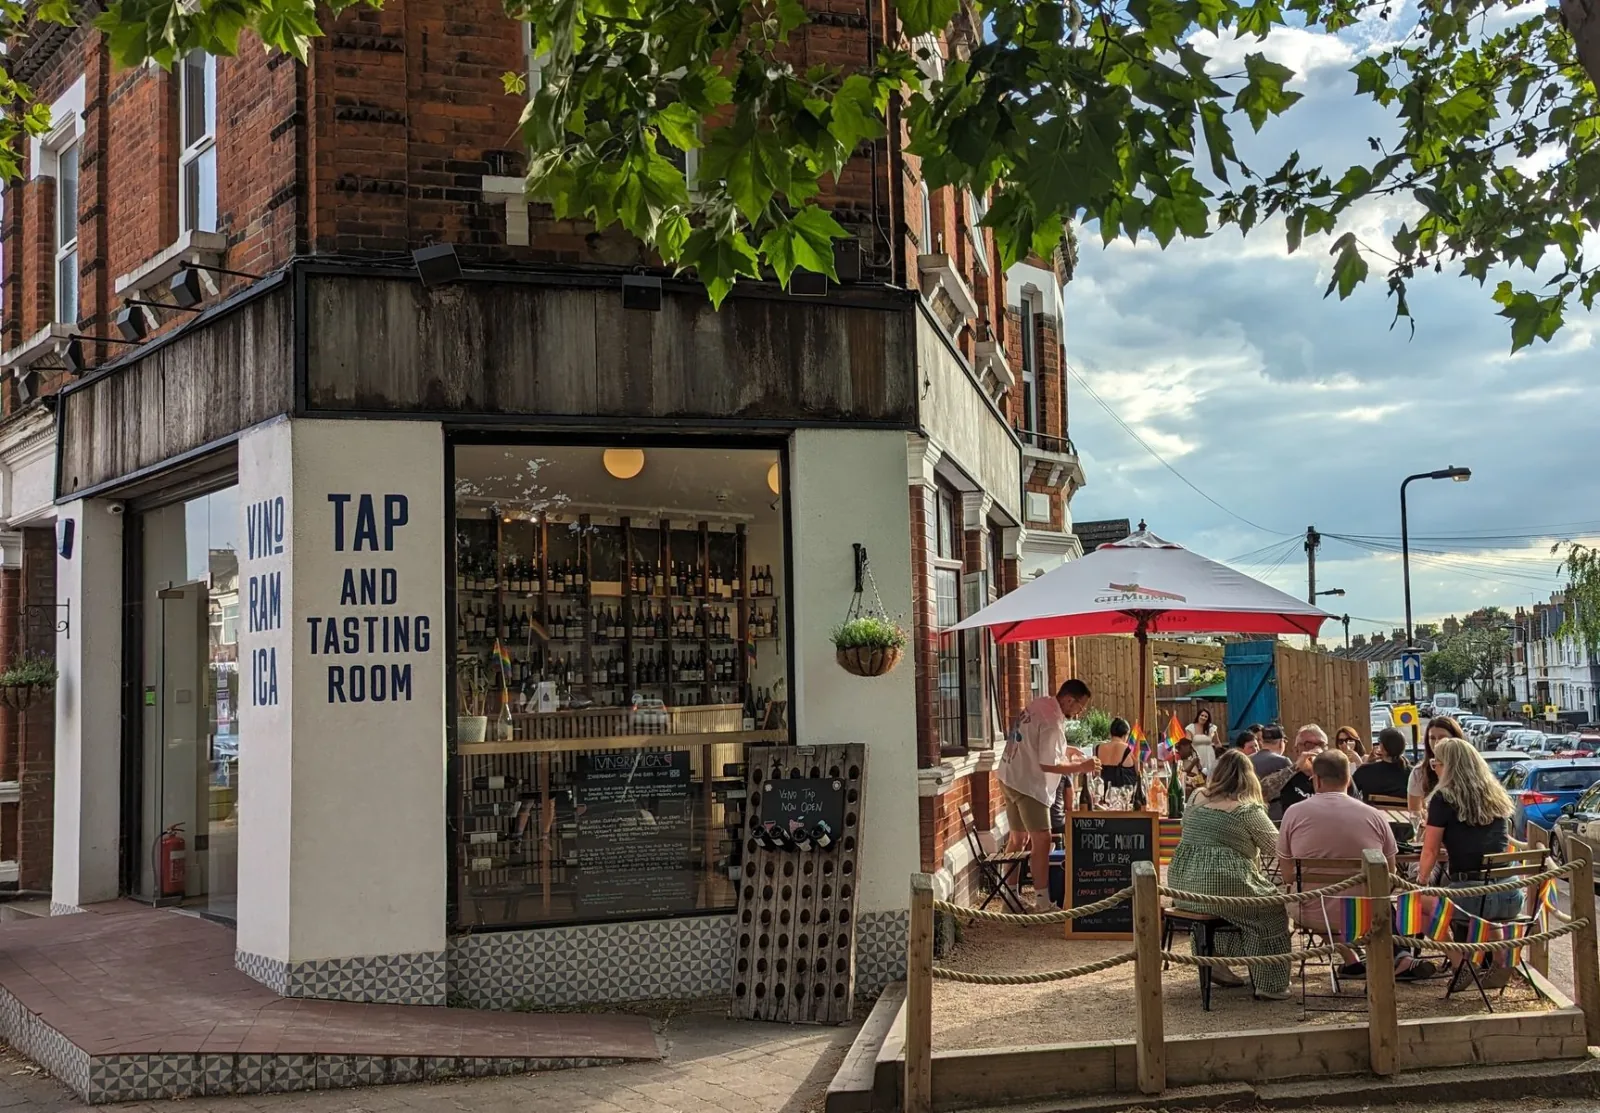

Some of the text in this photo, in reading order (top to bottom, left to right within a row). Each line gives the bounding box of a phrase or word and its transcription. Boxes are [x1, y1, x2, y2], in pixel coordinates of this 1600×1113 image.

[247, 496, 284, 560] VINO
[327, 493, 409, 552] TAP
[249, 571, 281, 633] RAM
[340, 568, 397, 606] AND
[306, 615, 430, 655] TASTING
[252, 647, 278, 706] ICA
[327, 663, 412, 704] ROOM
[781, 802, 823, 814] NOW OPEN
[1074, 819, 1105, 829] VINO TAP
[1081, 834, 1111, 850] PRIDE
[1093, 852, 1131, 864] POP UP BAR
